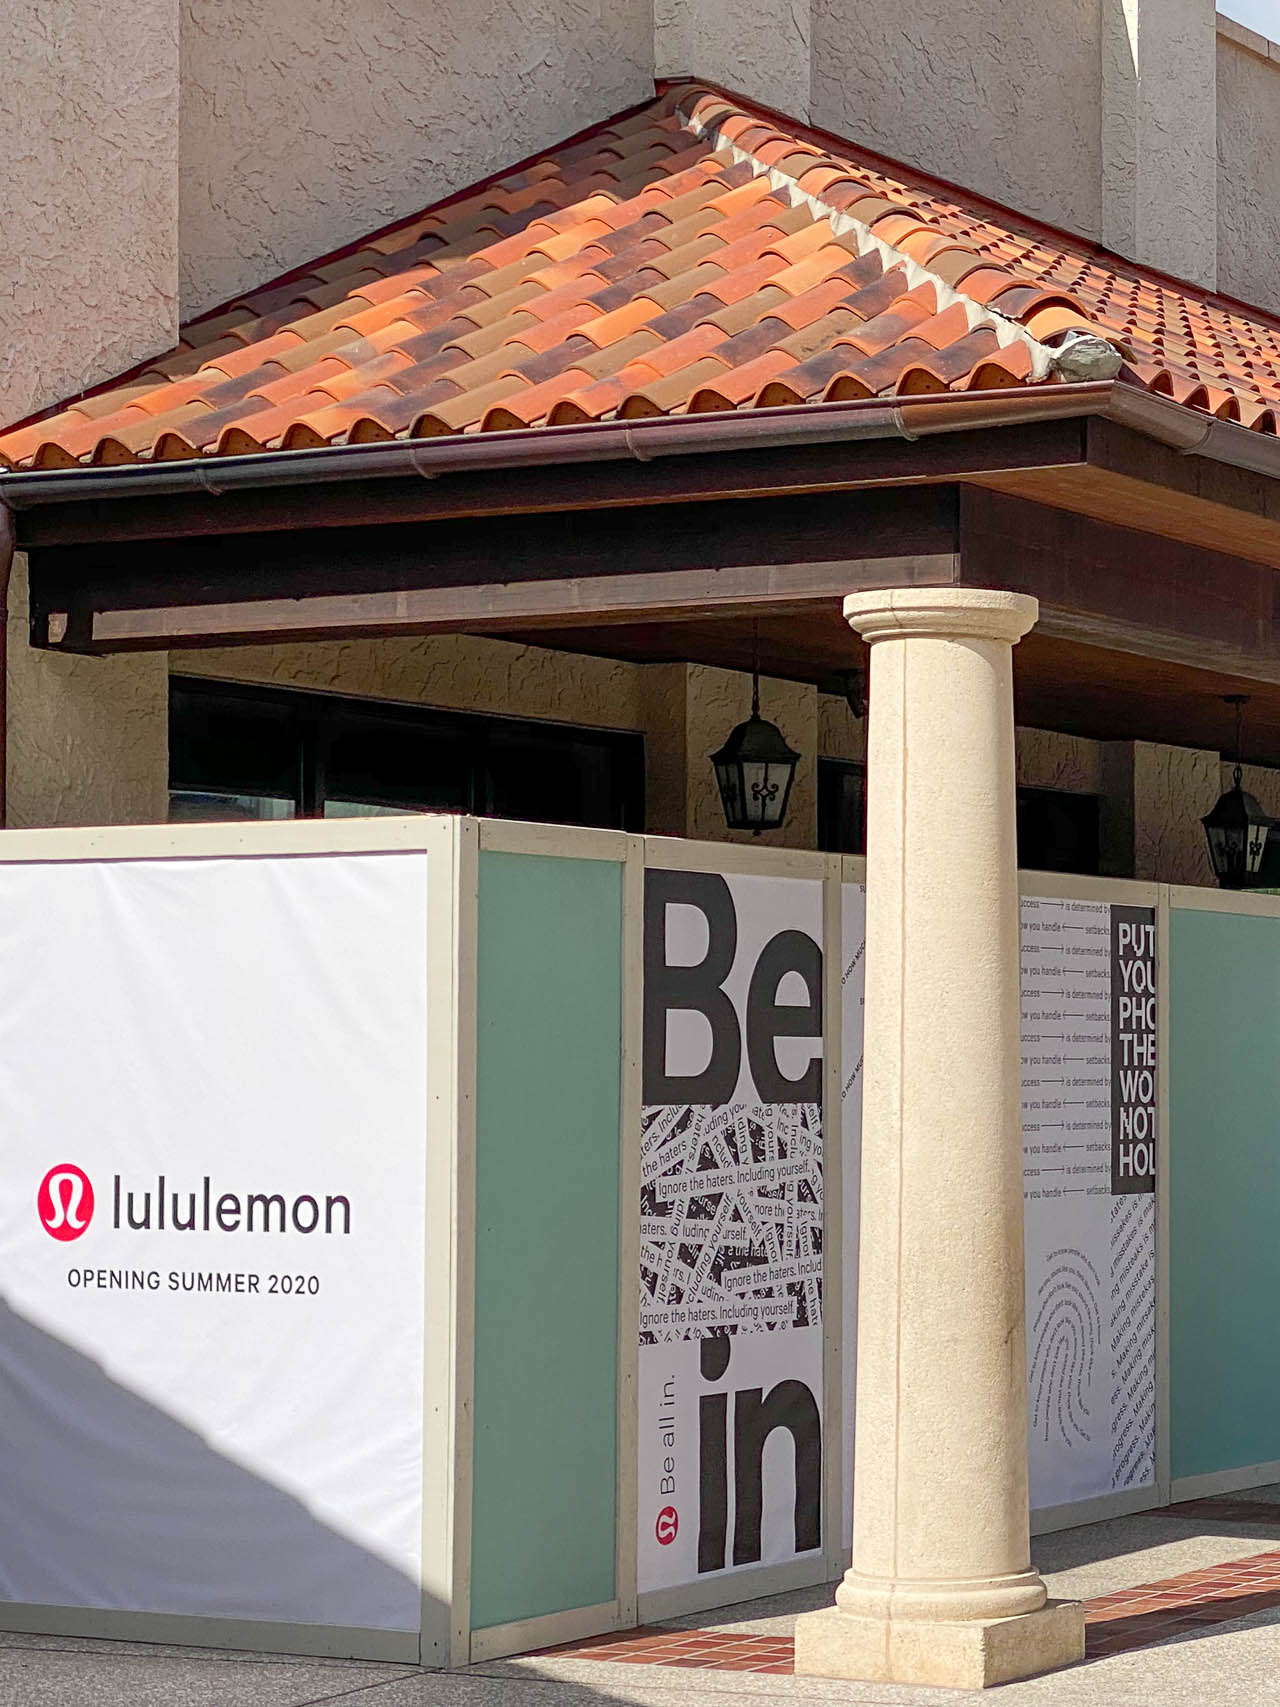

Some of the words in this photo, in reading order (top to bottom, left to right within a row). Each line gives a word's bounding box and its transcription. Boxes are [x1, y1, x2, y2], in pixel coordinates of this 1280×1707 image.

[1119, 922, 1155, 957] PUT
[643, 868, 823, 1105] Be
[1119, 1033, 1155, 1066] THE
[1119, 1070, 1155, 1104] WO
[658, 1180, 688, 1199] Ignore
[689, 1176, 705, 1191] the
[706, 1173, 736, 1188] haters.
[736, 1165, 775, 1182] Including
[776, 1158, 810, 1180] yourself.
[113, 1174, 350, 1234] lululemon
[640, 1221, 668, 1237] aters.
[68, 1268, 160, 1290] OPENING
[168, 1271, 260, 1294] SUMMER
[268, 1274, 320, 1295] 2020
[724, 1275, 752, 1292] Ignore
[752, 1269, 768, 1286] the
[769, 1264, 797, 1281] haters.
[640, 1311, 669, 1329] Ignore
[670, 1307, 686, 1323] the
[687, 1306, 718, 1321] haters.
[719, 1301, 759, 1320] Including
[759, 1299, 795, 1317] yourself.
[1110, 1316, 1131, 1352] Making
[1116, 1332, 1138, 1368] Making
[1121, 1349, 1142, 1385] Making
[1127, 1364, 1149, 1400] Making
[1132, 1381, 1154, 1417] Making
[659, 1416, 675, 1448] all
[698, 1336, 822, 1574] in
[660, 1456, 675, 1495] Be
